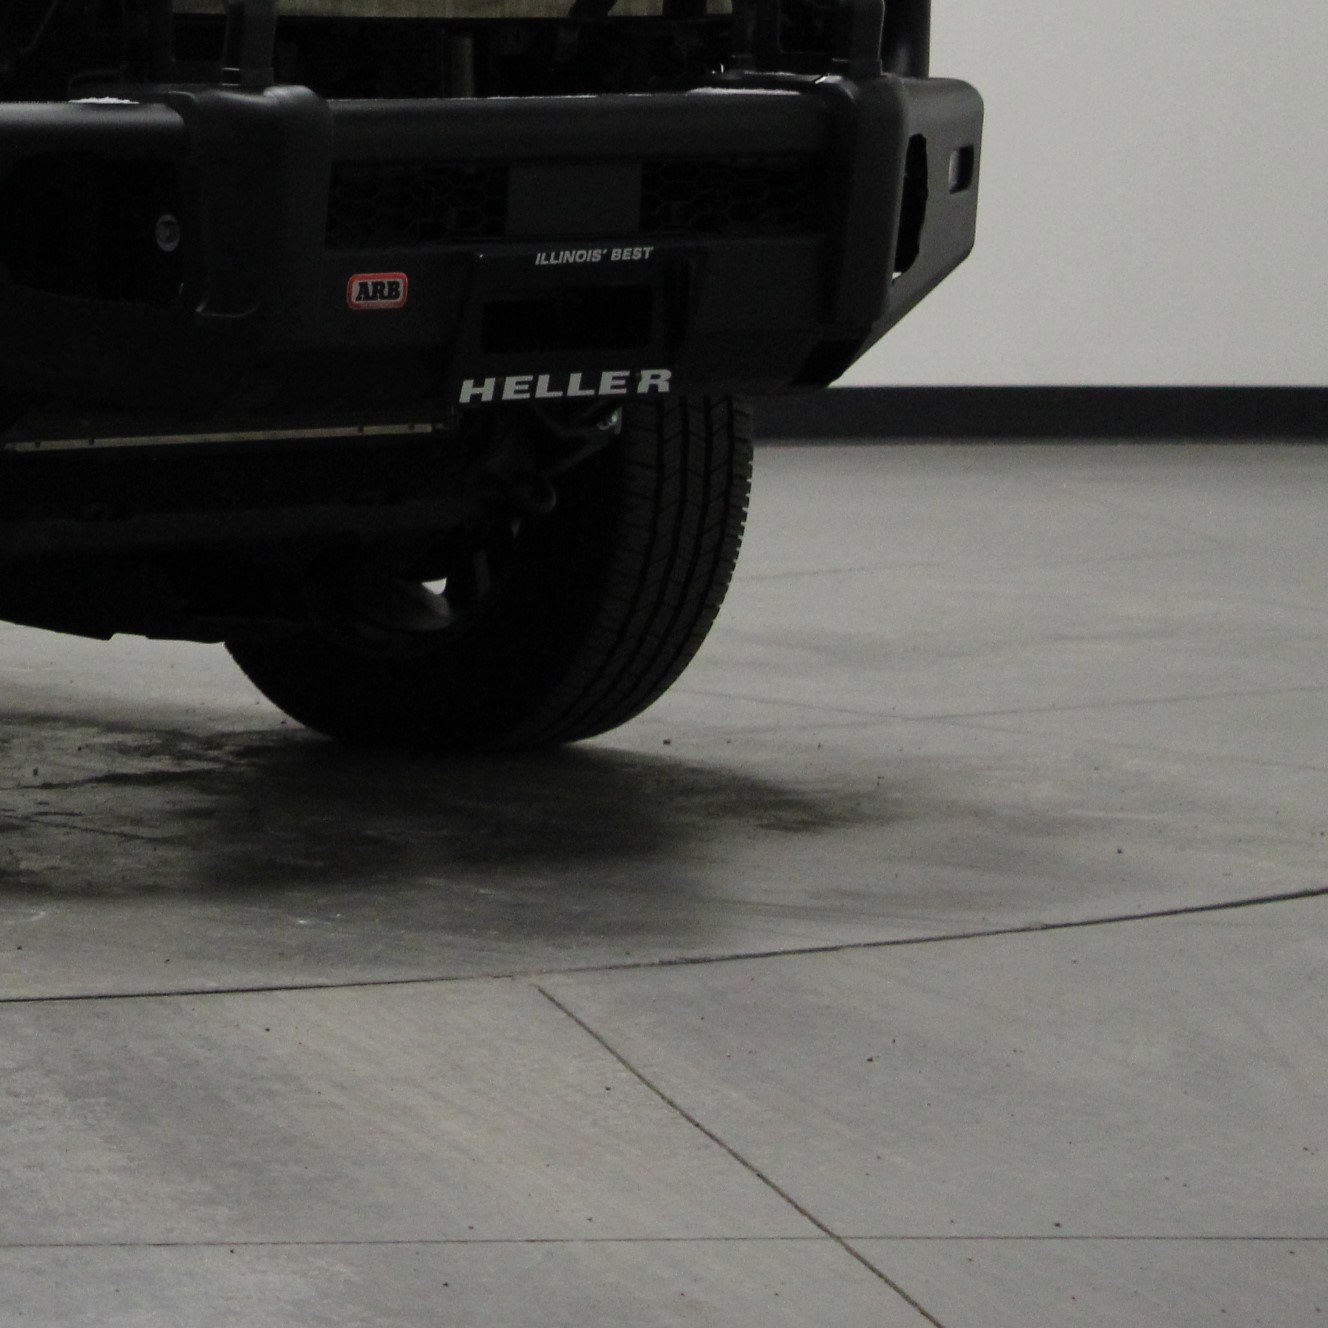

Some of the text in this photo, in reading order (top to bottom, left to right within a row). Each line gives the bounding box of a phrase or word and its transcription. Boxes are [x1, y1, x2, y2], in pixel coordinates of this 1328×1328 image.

[610, 246, 654, 262] BEST
[355, 280, 401, 301] ARB
[458, 369, 672, 404] HELLER
